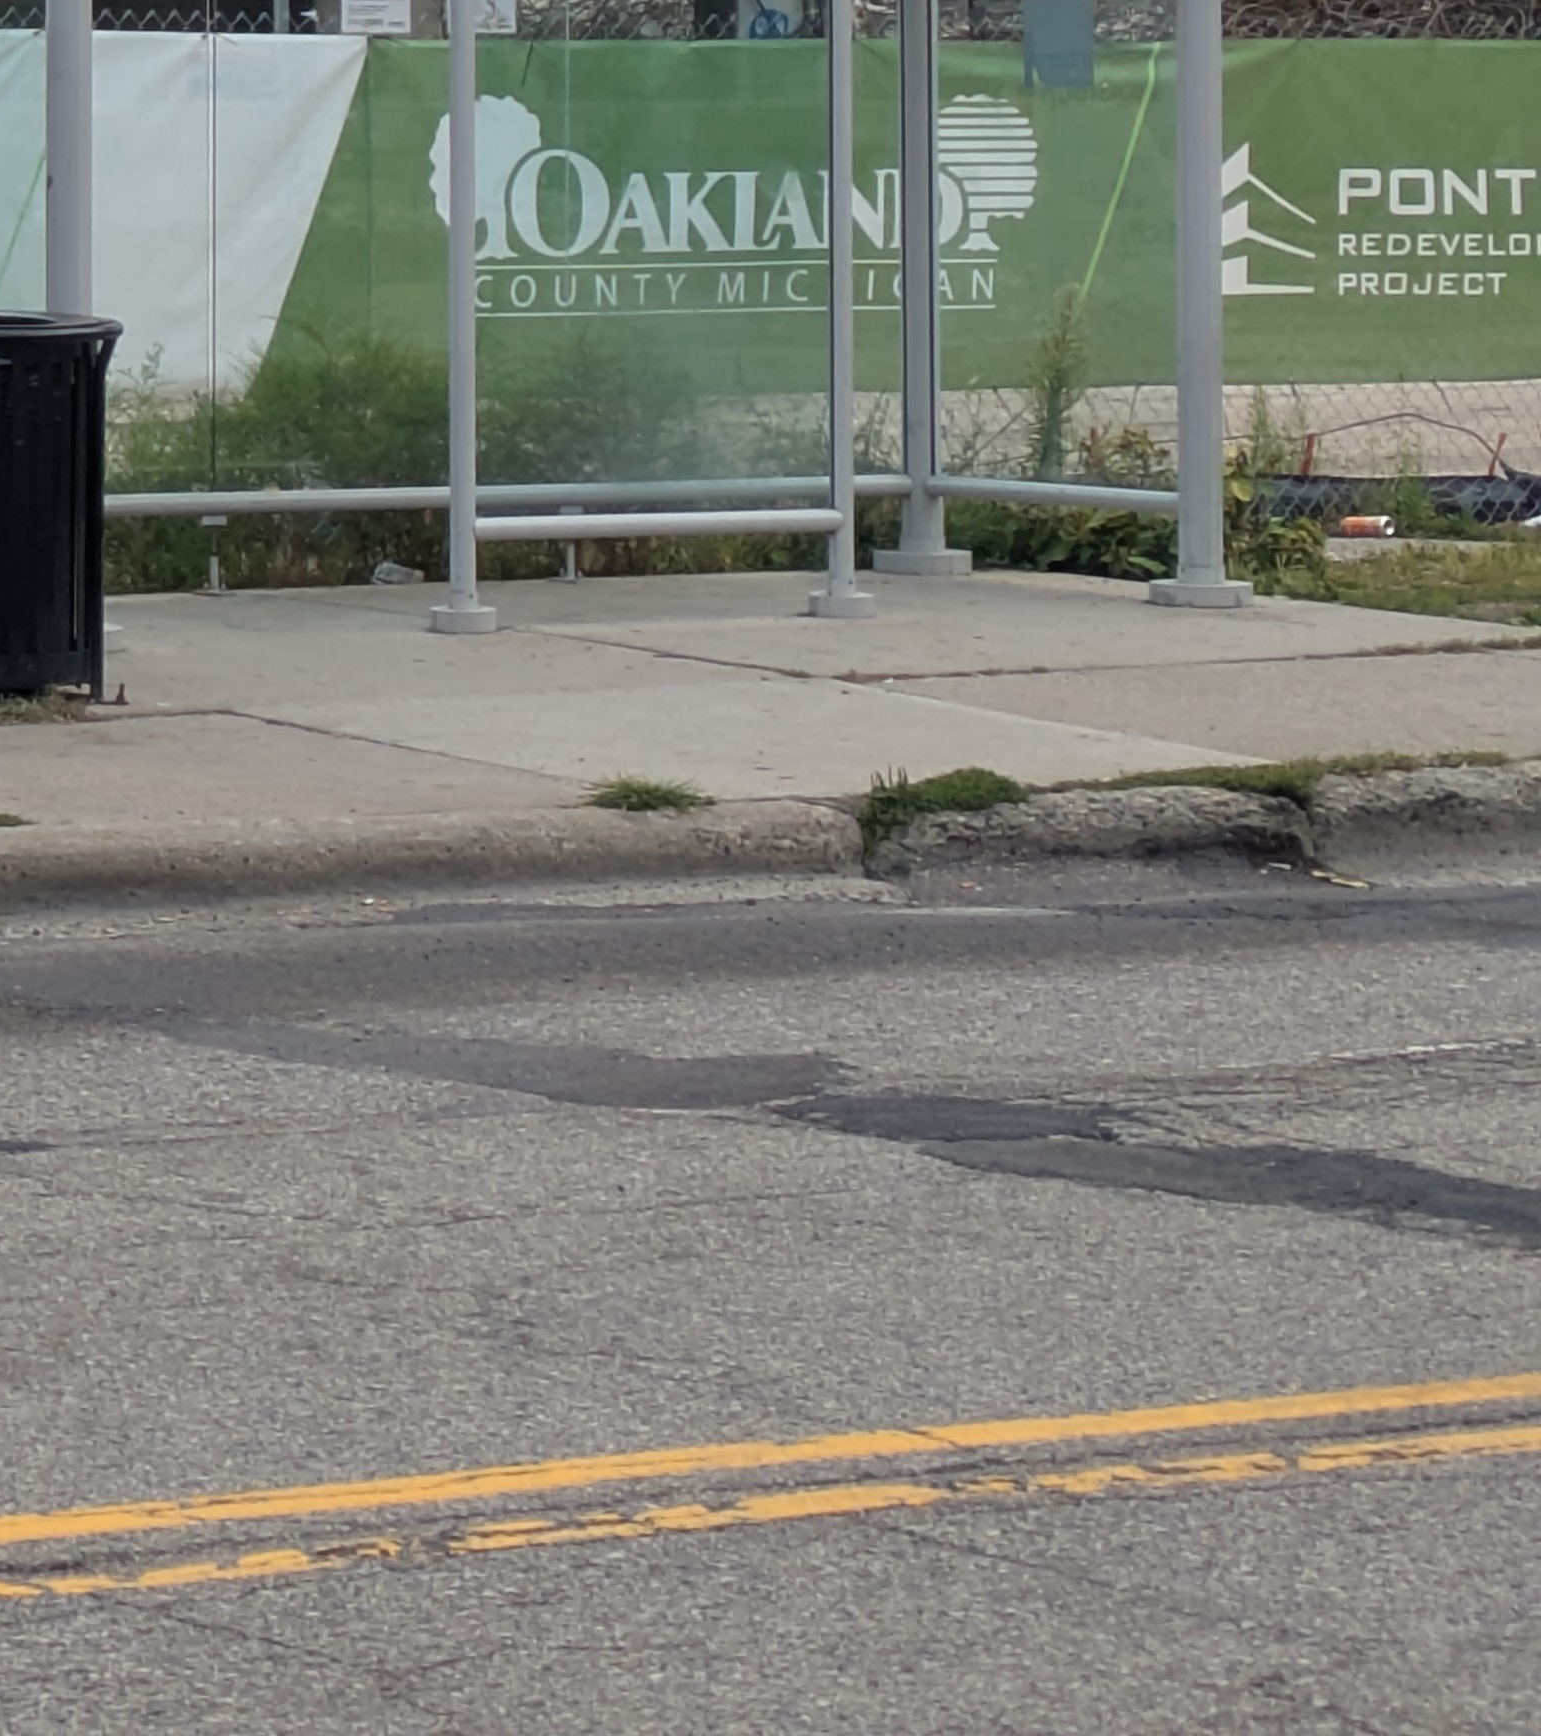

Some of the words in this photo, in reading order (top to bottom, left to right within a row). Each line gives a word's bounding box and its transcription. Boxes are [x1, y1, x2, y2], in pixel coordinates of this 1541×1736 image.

[1338, 168, 1537, 215] PONT
[474, 273, 687, 308] COUNTY
[717, 267, 996, 306] MICIAN
[1338, 272, 1508, 296] PROJECT
